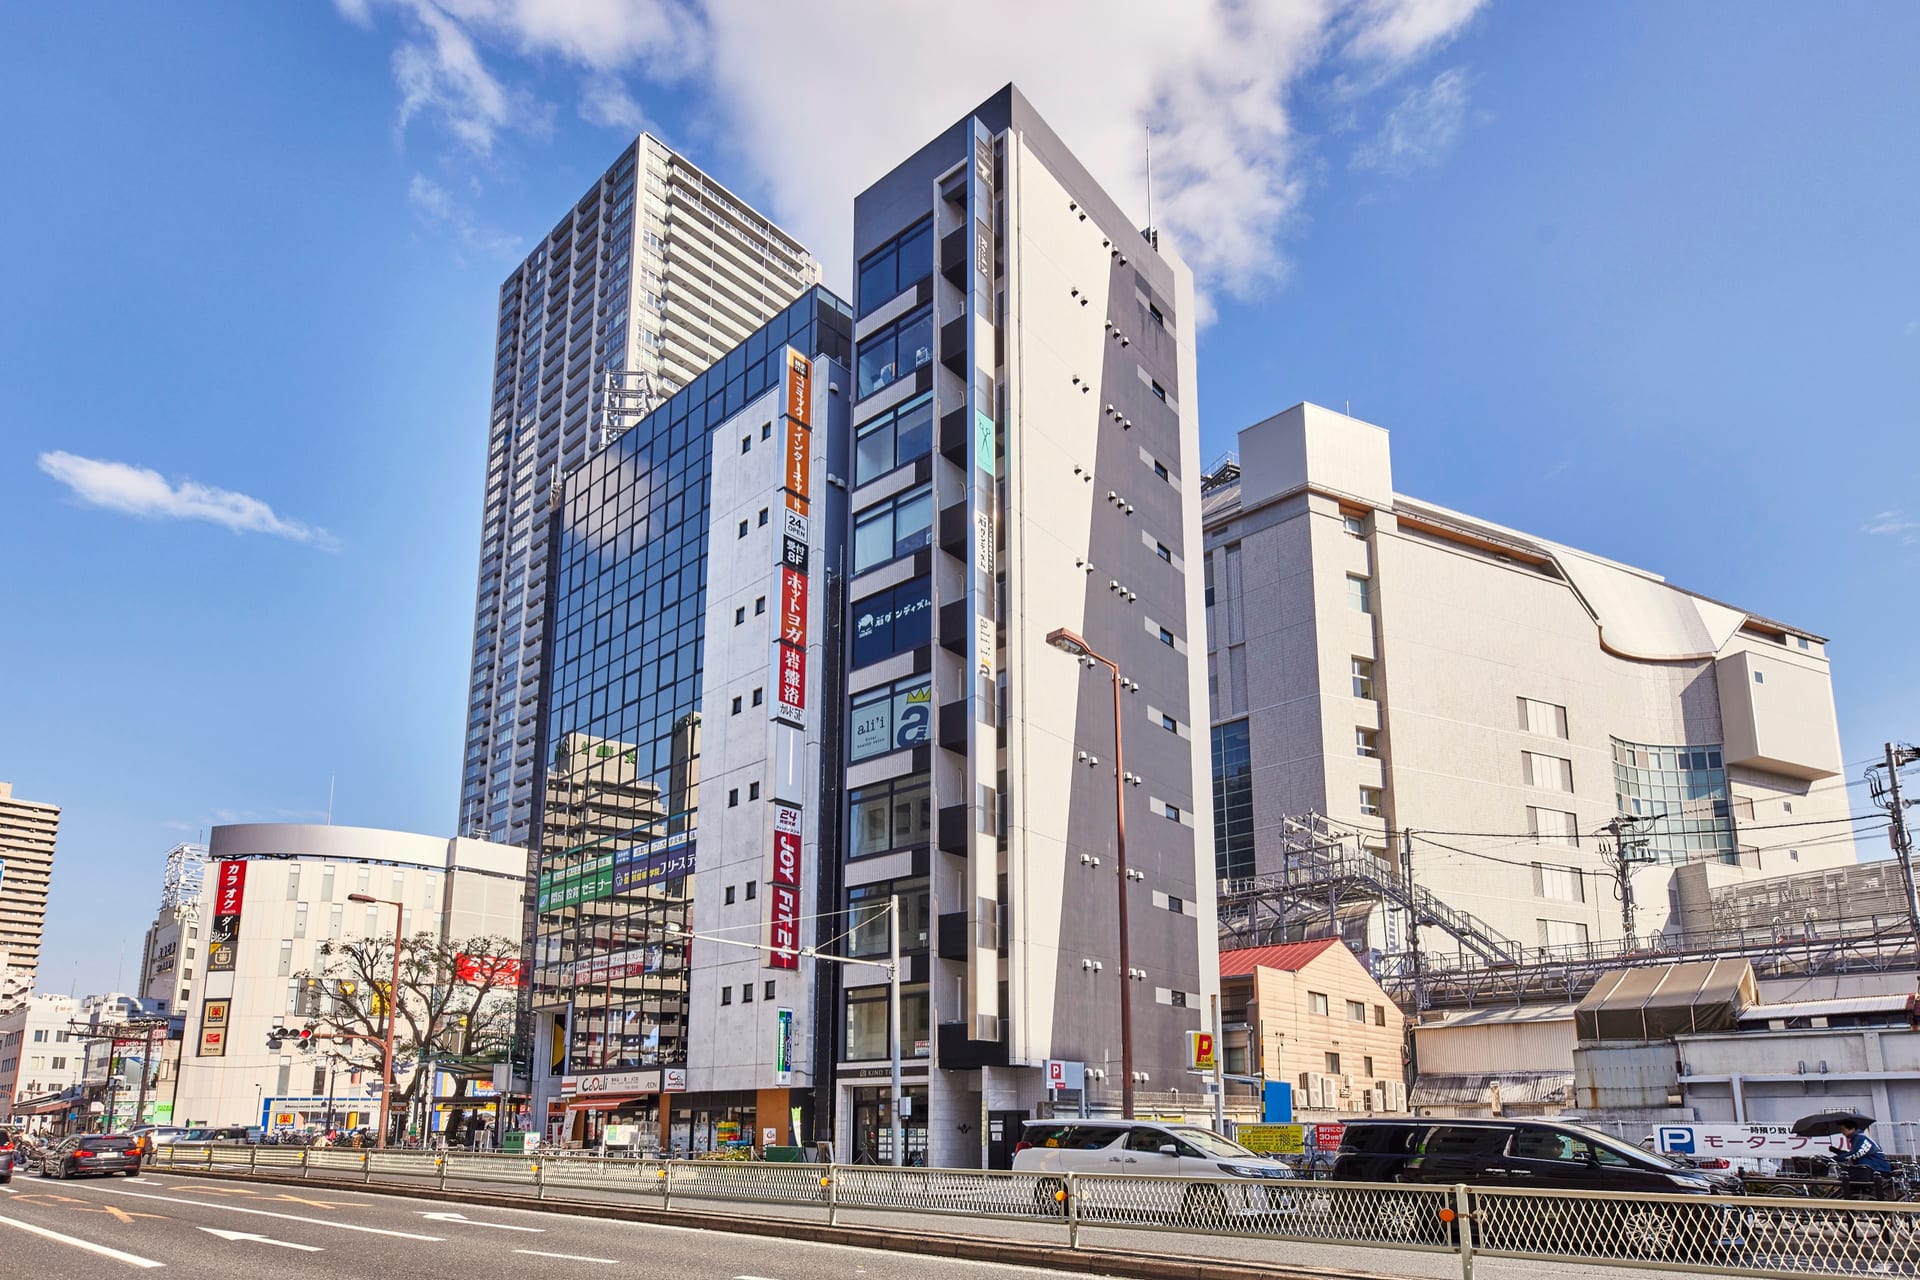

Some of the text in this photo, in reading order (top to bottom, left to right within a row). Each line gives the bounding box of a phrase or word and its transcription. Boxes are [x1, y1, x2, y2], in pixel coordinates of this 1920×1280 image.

[787, 524, 806, 538] OPEN
[786, 540, 805, 556] 受付
[787, 551, 802, 565] 8F
[784, 575, 802, 705] ホットヨガ 岩盤浴
[857, 716, 885, 735] ali'i
[780, 809, 797, 821] 24
[223, 864, 240, 909] カラオケ
[220, 915, 234, 942] ダーツ
[214, 945, 232, 965] 歯
[1196, 1034, 1213, 1062] P
[1052, 1065, 1060, 1078] P
[1663, 1131, 1691, 1152] P
